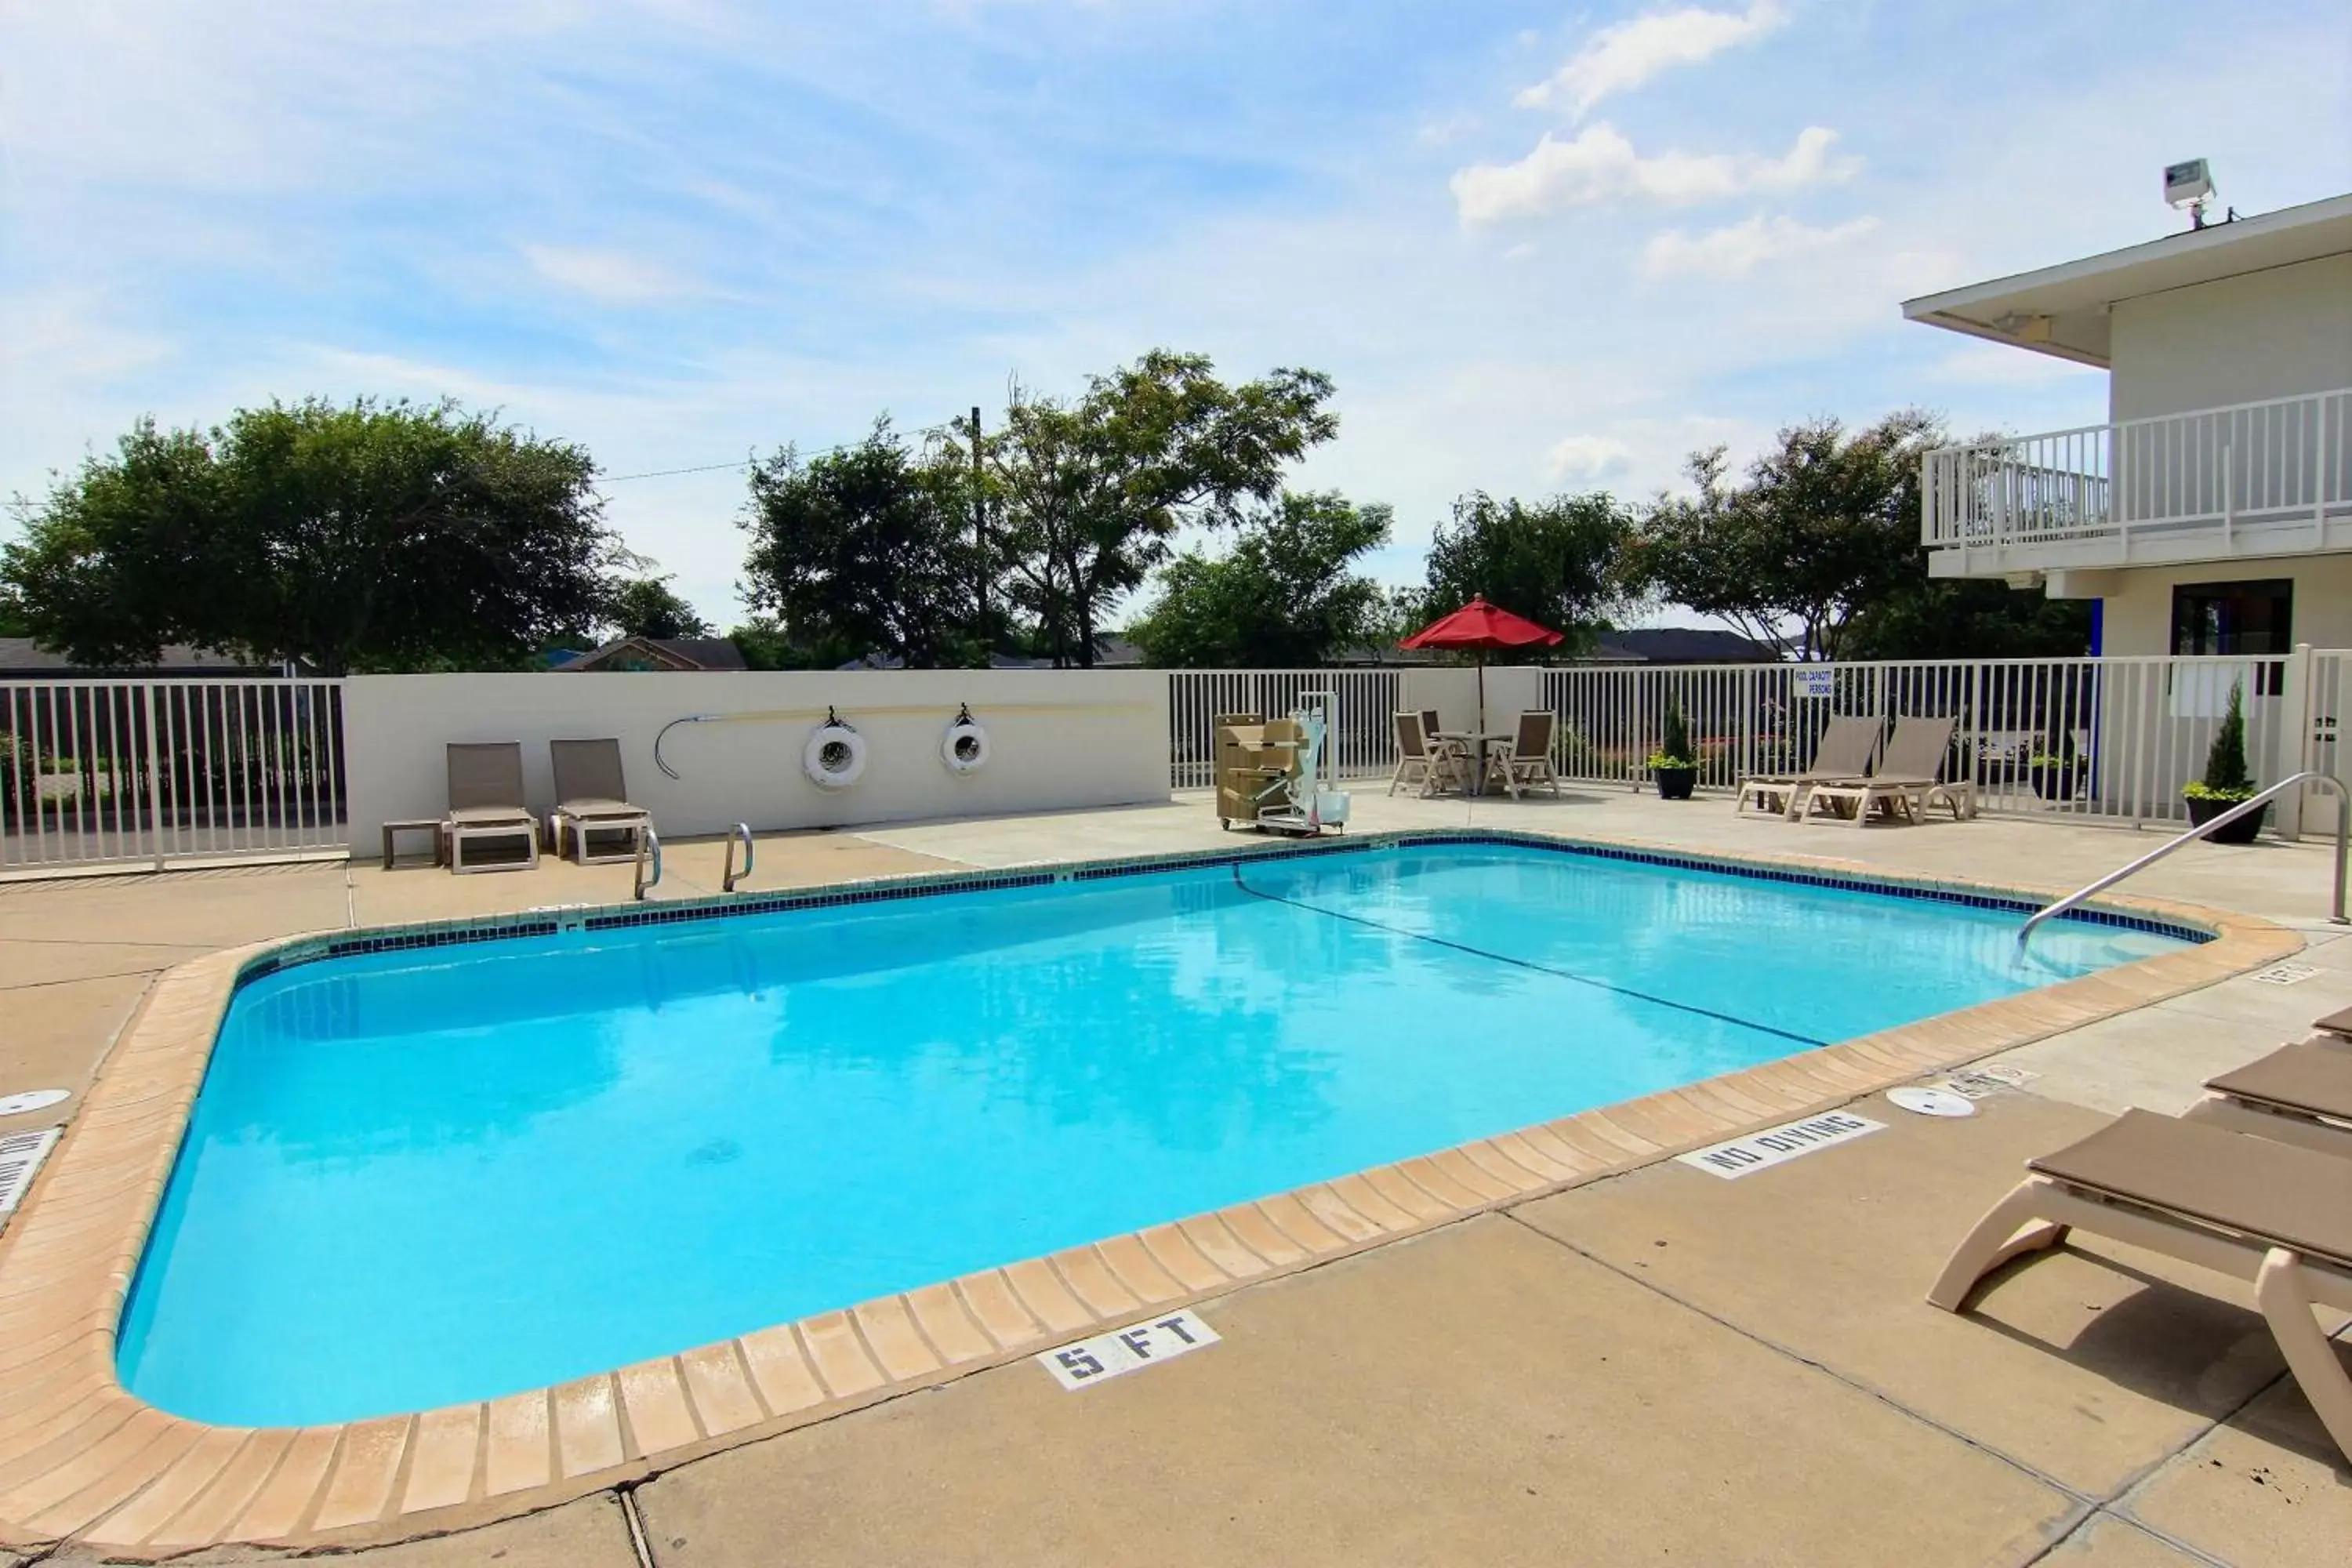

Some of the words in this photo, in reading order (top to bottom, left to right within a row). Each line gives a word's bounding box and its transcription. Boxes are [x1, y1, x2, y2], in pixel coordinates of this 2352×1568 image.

[1809, 683, 1832, 695] PERSONS
[1701, 1147, 1763, 1171] NO
[1754, 1115, 1866, 1152] DIVING
[1054, 1348, 1105, 1380] 5
[1118, 1316, 1196, 1359] FT
